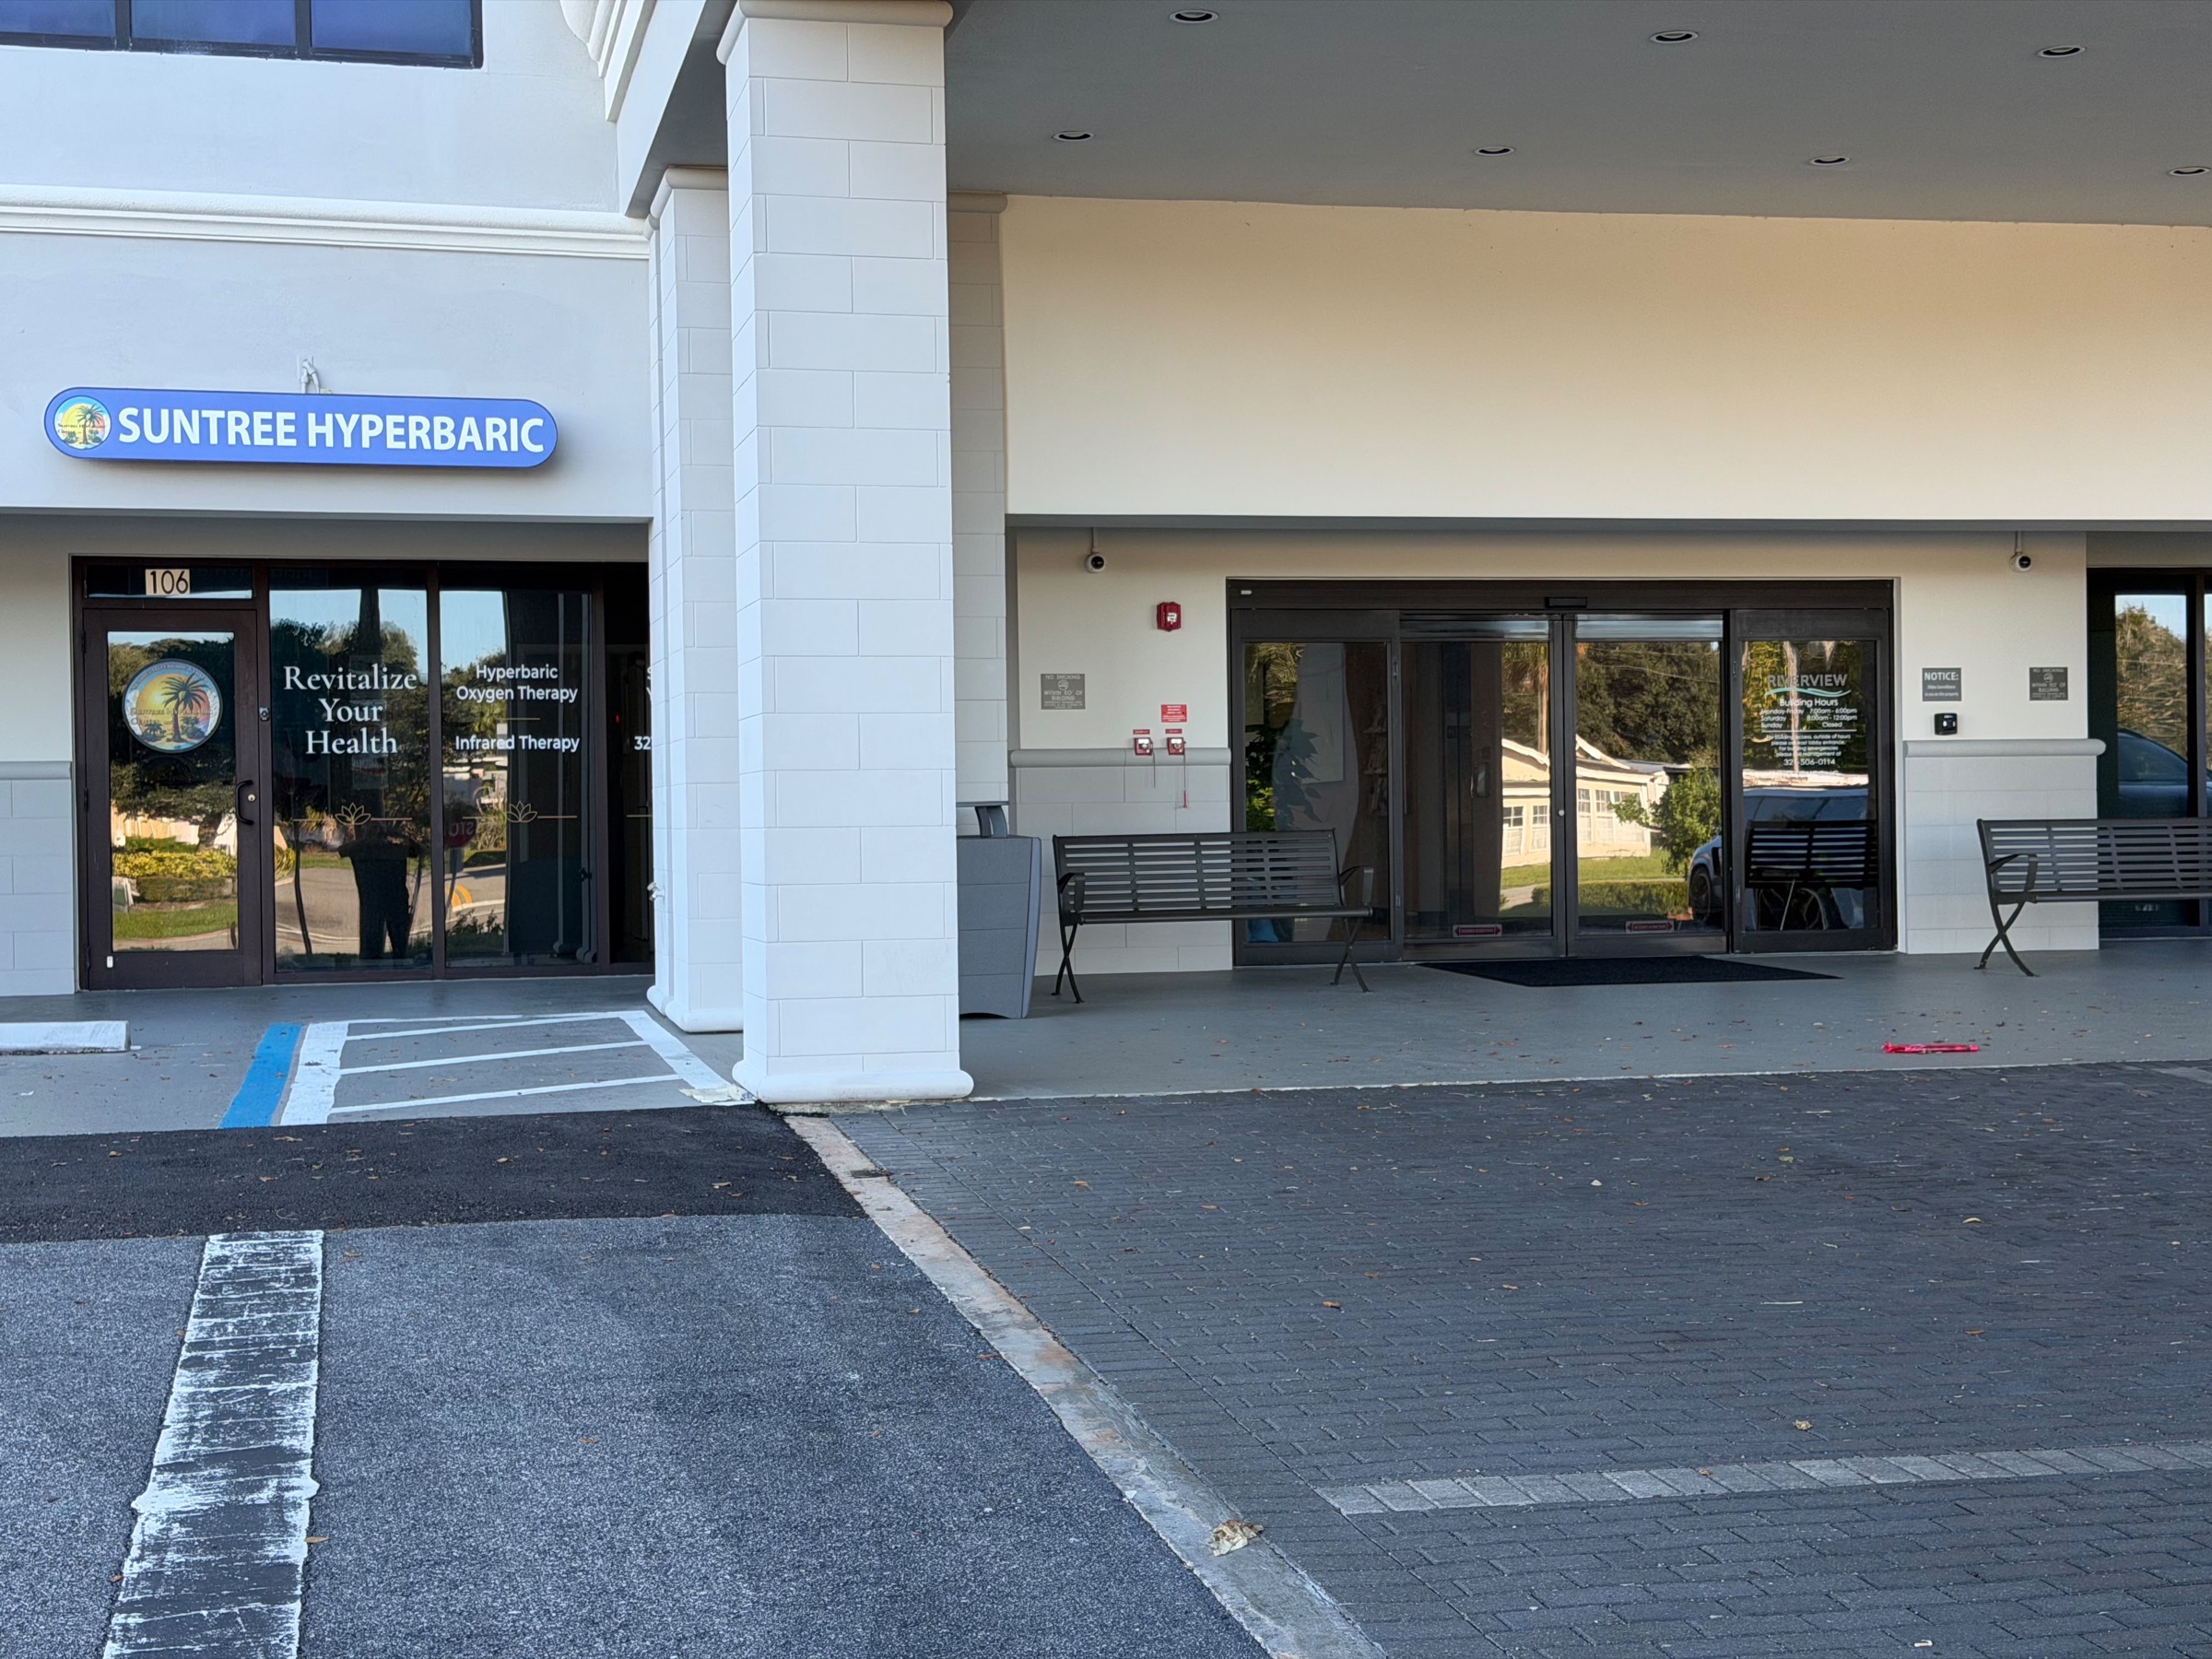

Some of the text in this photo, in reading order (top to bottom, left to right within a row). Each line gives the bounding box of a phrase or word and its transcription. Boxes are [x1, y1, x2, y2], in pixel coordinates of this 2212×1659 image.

[117, 406, 545, 453] SUNTREE HYPERBARIC
[148, 569, 190, 595] 106
[282, 663, 418, 691] Revitalize
[476, 663, 559, 684] Hyperbaric
[1924, 671, 1959, 681] NOTICE:
[456, 685, 579, 704] Oxygen Therapy
[1814, 698, 1839, 707] Hours
[317, 697, 383, 723] Your
[305, 726, 398, 755] Health
[455, 735, 581, 754] Infrared Therapy
[1783, 758, 1836, 766] 32-506-0114
